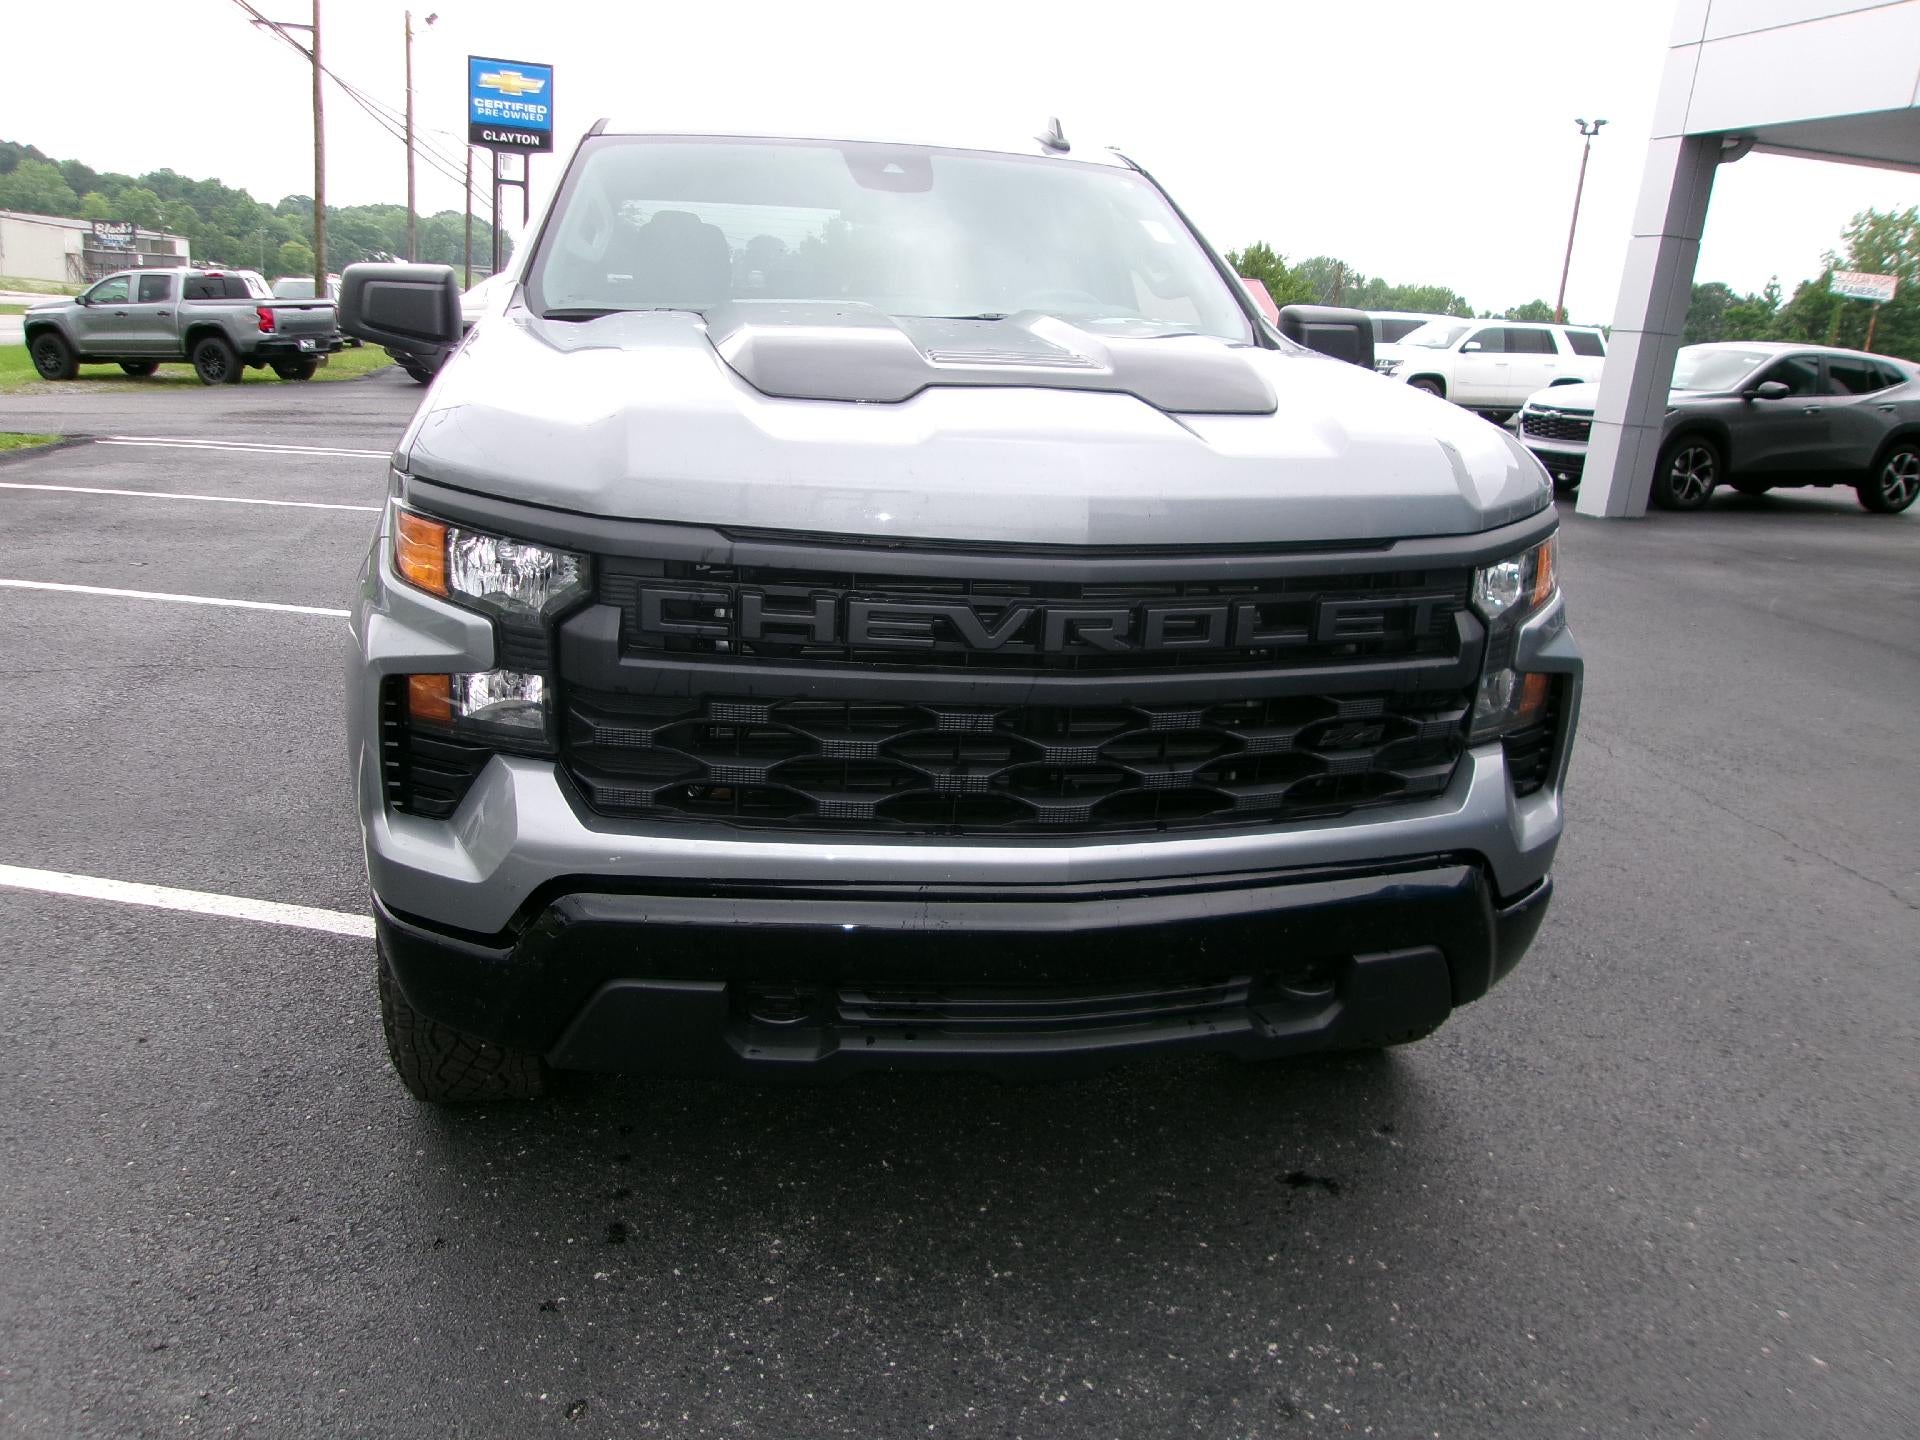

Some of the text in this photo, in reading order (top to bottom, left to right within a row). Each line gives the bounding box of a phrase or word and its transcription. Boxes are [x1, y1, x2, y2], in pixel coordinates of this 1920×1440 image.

[474, 98, 547, 114] CERTIFIED
[478, 107, 543, 121] PRE-OWNED
[483, 130, 540, 145] CLAYTON
[641, 590, 1455, 652] CHEVROLET
